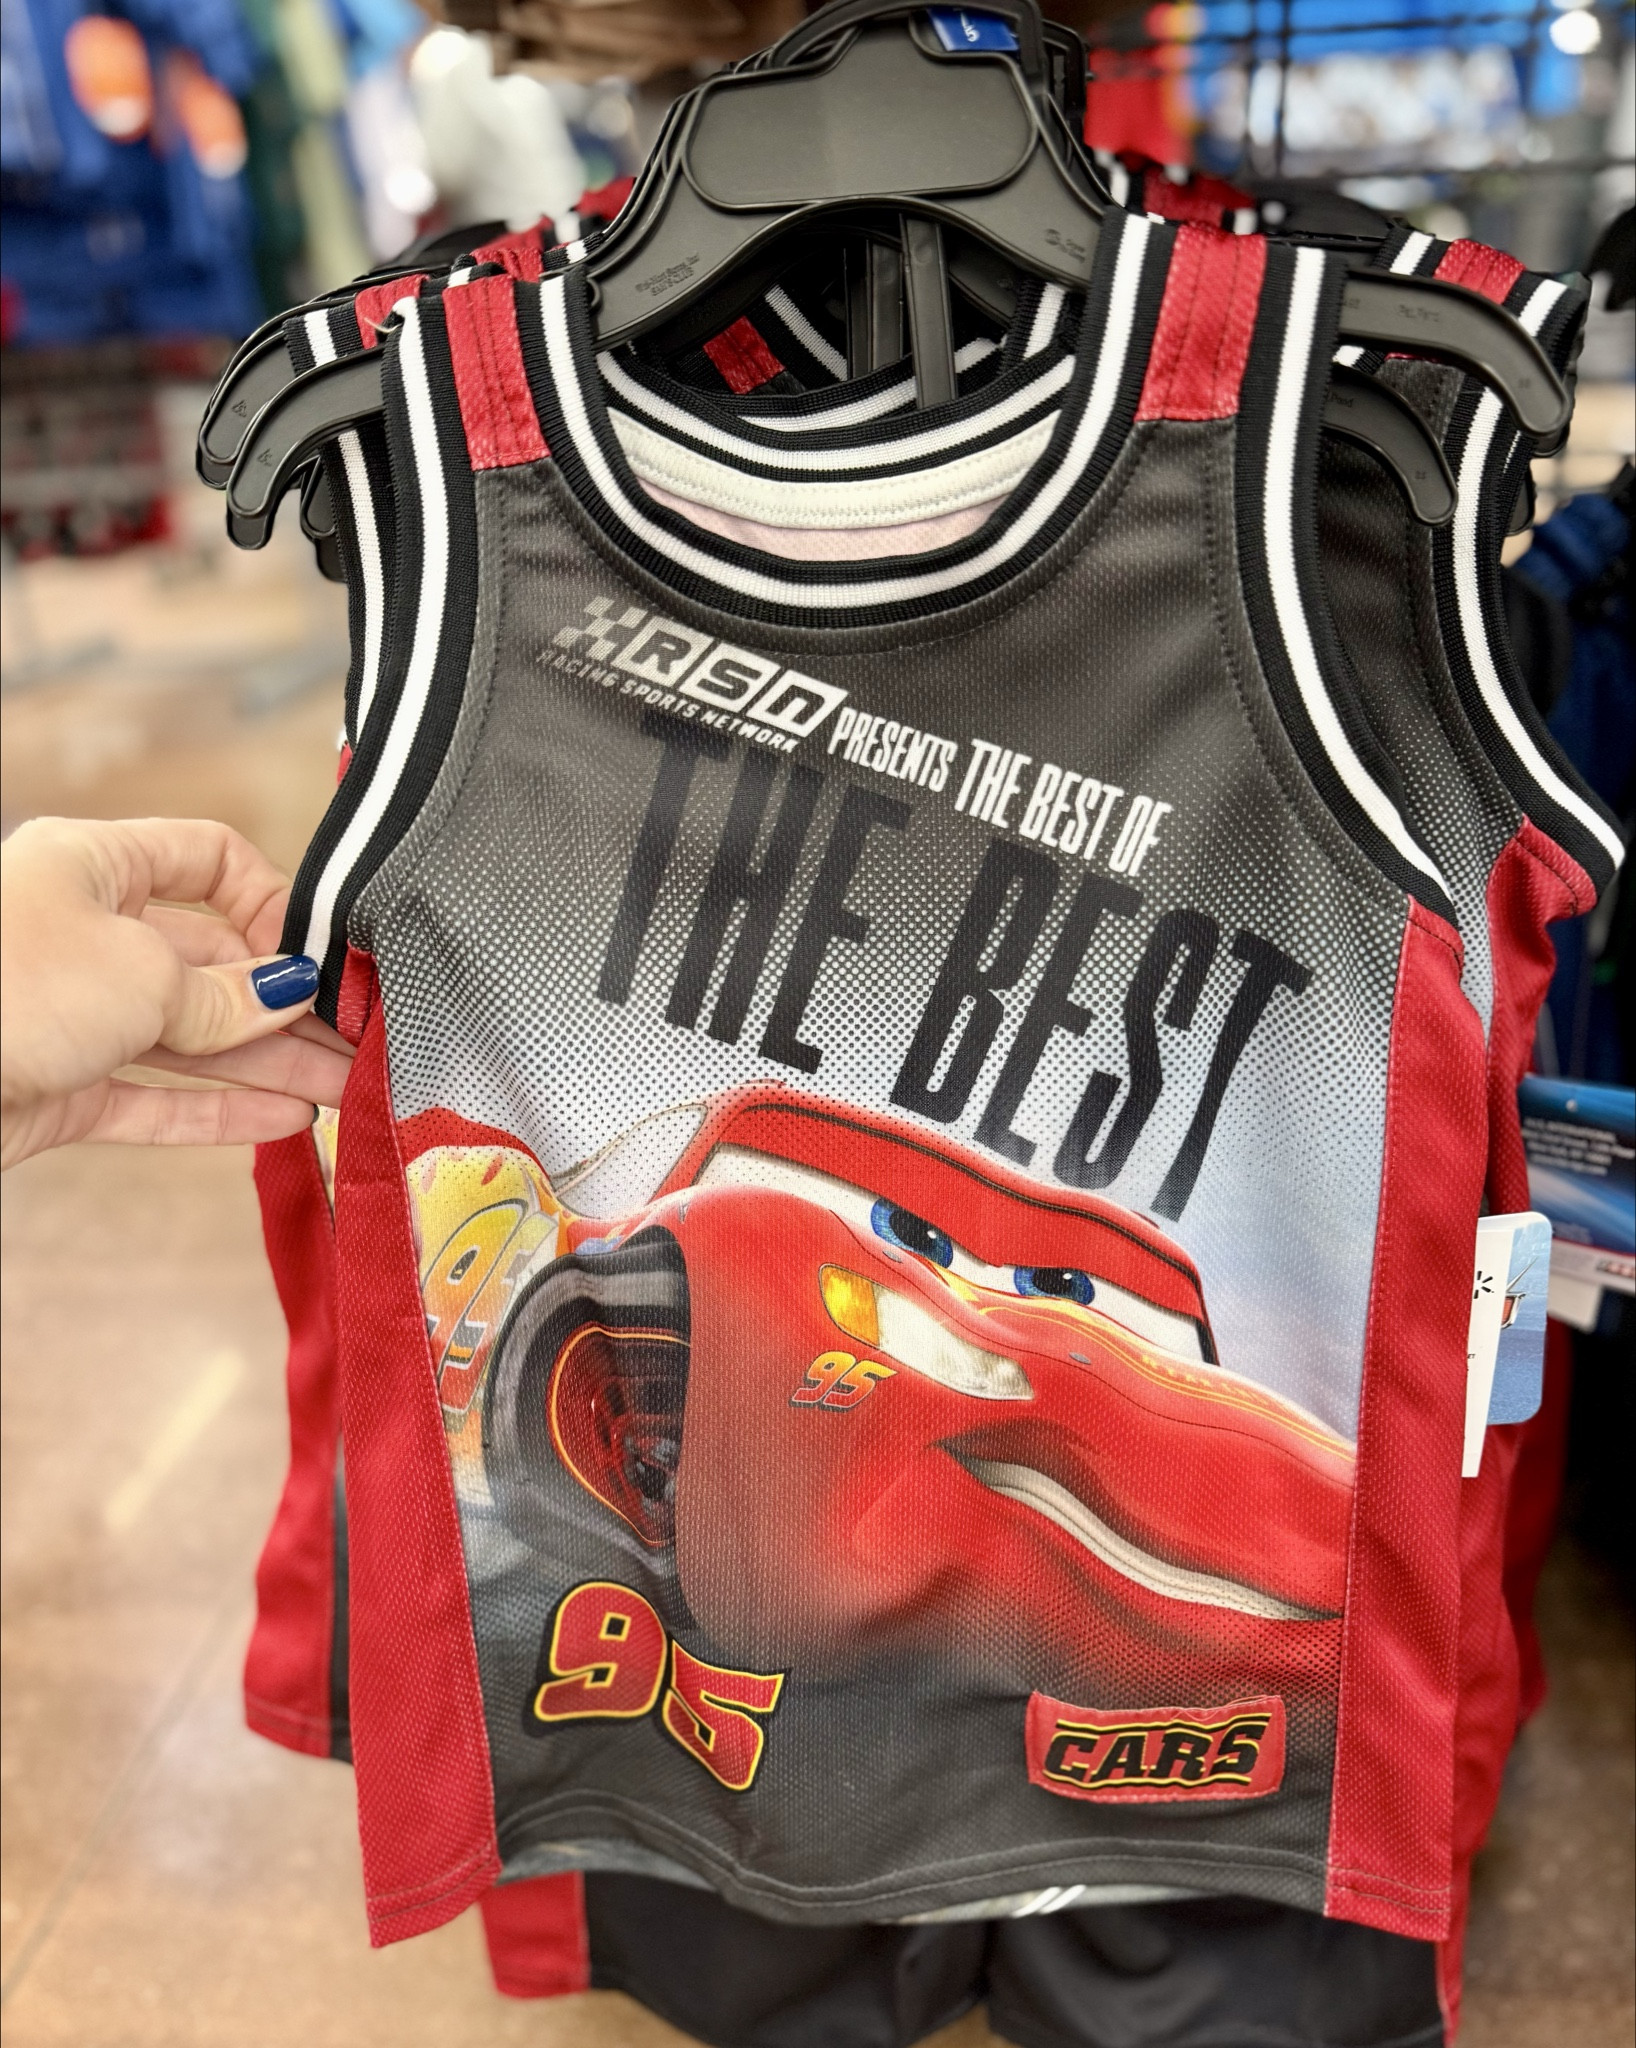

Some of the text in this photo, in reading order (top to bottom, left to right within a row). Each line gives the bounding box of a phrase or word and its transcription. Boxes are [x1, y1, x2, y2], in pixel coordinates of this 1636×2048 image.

[536, 649, 801, 753] RACING SPORTS NETWORK
[827, 706, 1173, 877] PRESENTS THE BEST OF
[599, 709, 1314, 1222] THE BEST
[789, 1350, 898, 1412] 95
[533, 1580, 785, 1791] 95
[1044, 1717, 1270, 1785] CARS
